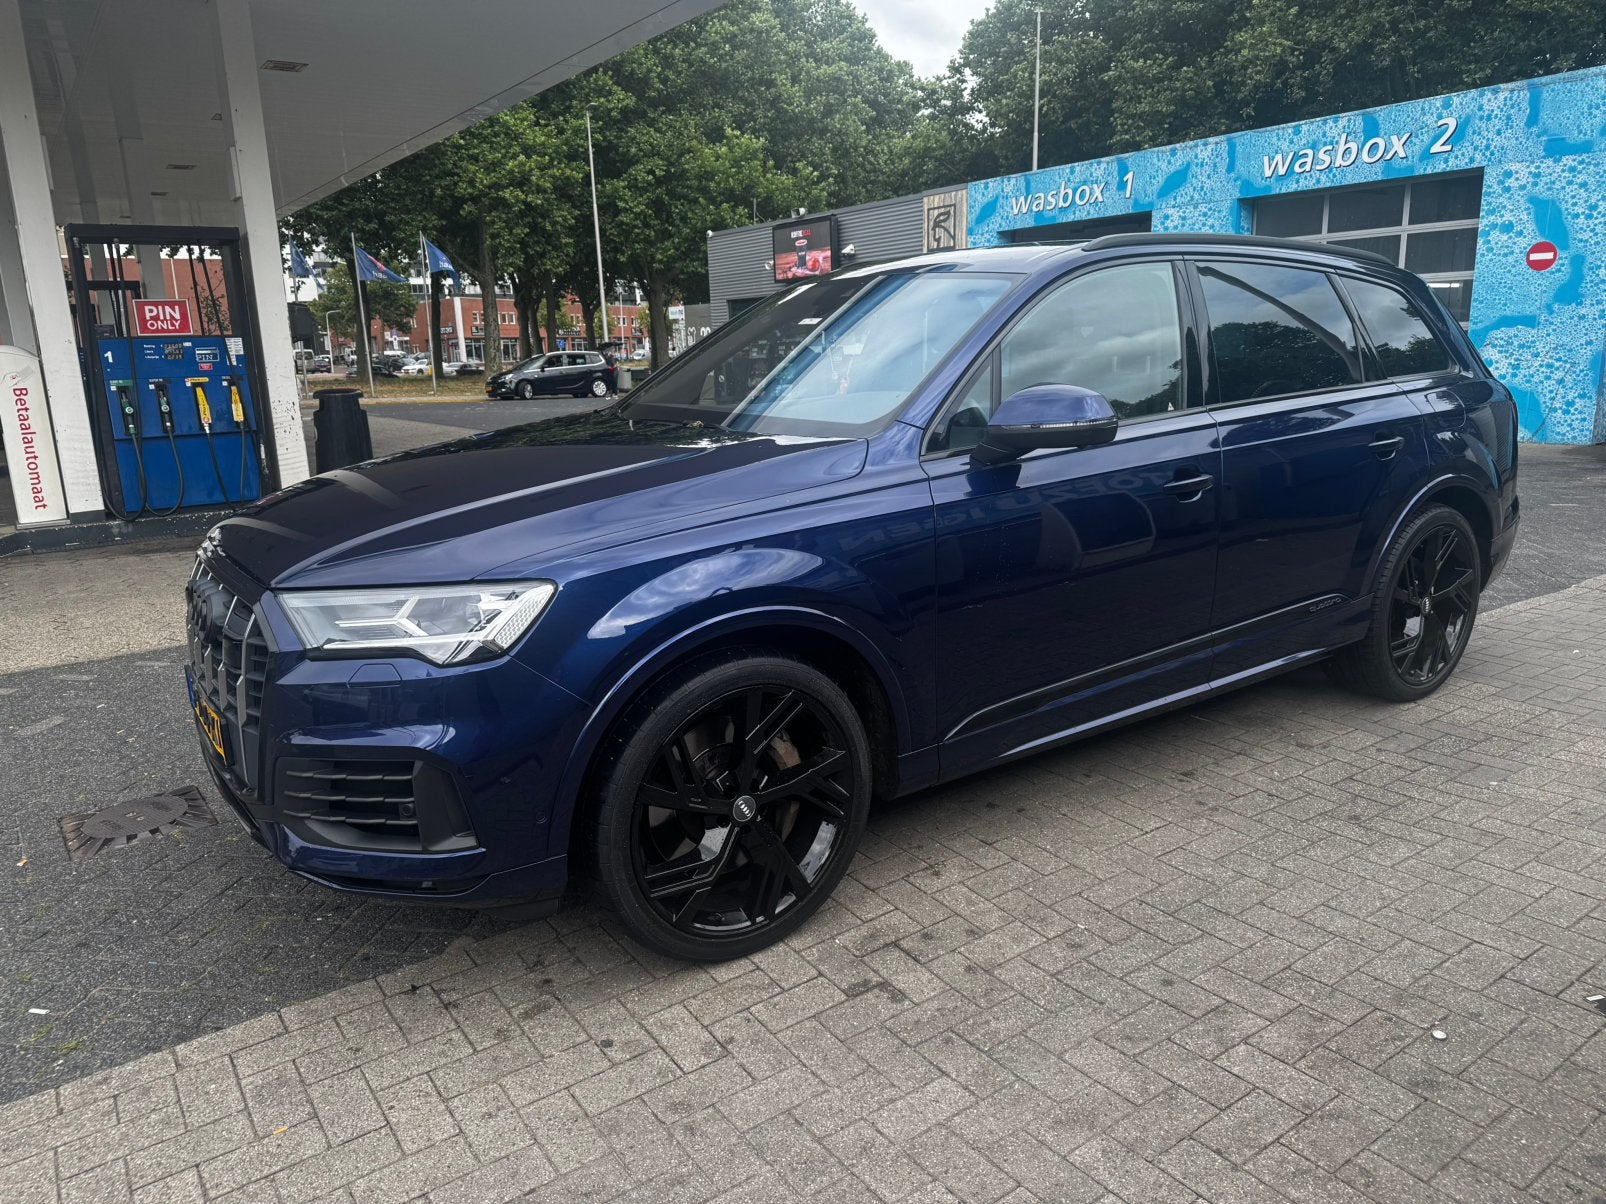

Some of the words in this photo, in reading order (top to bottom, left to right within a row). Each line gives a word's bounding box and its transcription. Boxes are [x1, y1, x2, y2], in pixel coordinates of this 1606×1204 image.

[1263, 132, 1412, 179] wasbox
[1430, 116, 1458, 155] 2
[1012, 181, 1107, 215] wasbox
[1123, 170, 1134, 199] 1
[144, 305, 180, 320] PIN
[147, 320, 181, 330] ONLY
[104, 351, 113, 363] 1
[13, 387, 47, 510] Betaalautomaat
